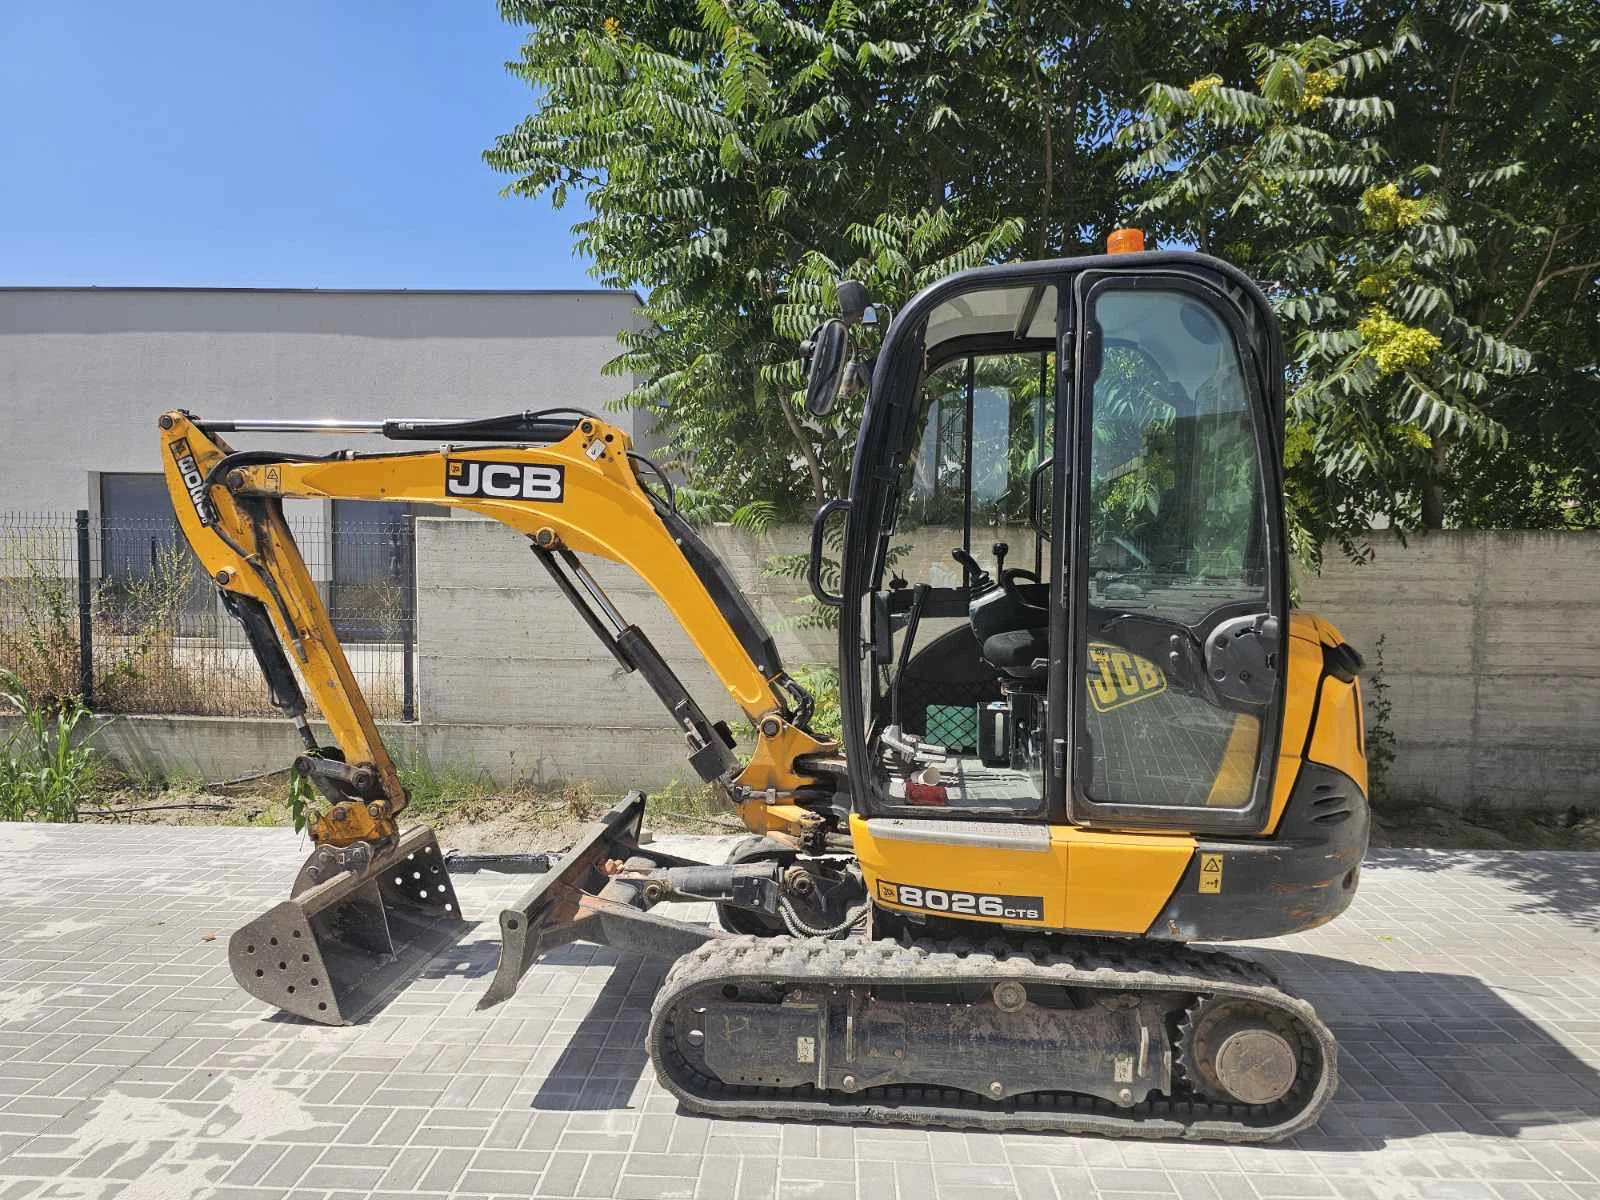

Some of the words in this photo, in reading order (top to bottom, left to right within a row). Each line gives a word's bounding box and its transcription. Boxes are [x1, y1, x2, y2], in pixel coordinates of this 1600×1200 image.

[449, 463, 561, 498] JCB
[1088, 649, 1159, 703] JCB
[900, 886, 1003, 916] 8026
[1004, 908, 1039, 918] CTS
